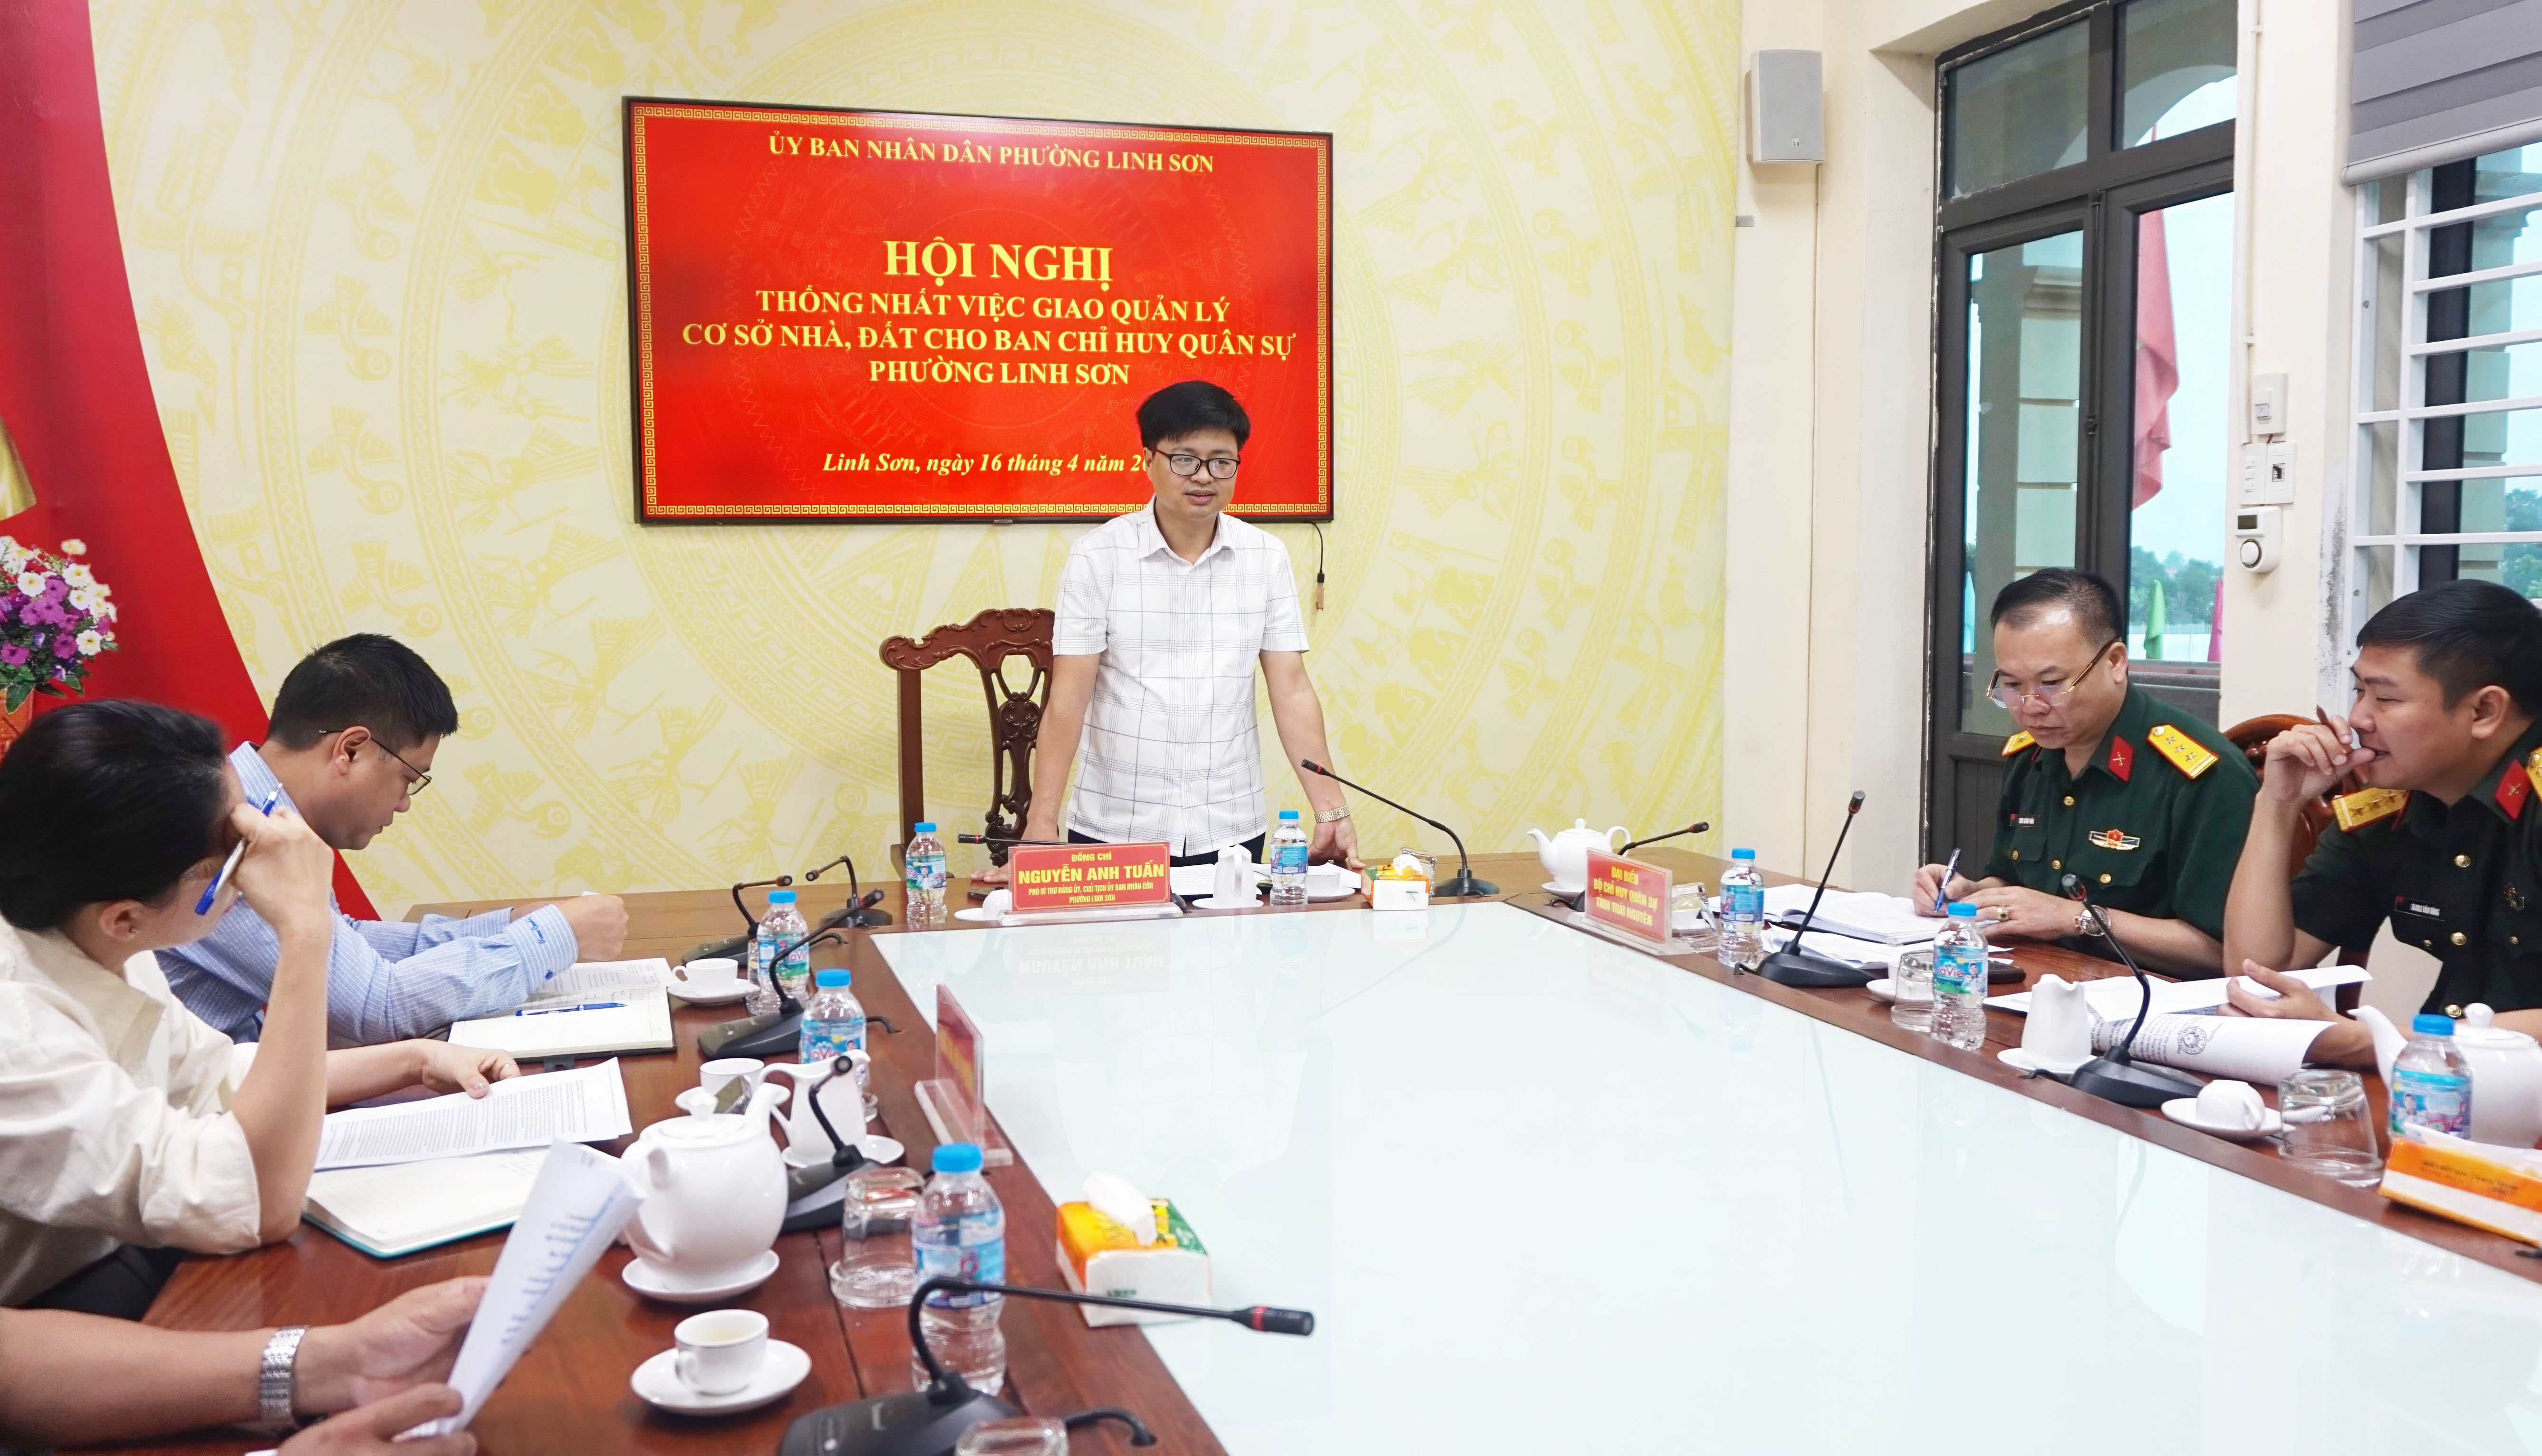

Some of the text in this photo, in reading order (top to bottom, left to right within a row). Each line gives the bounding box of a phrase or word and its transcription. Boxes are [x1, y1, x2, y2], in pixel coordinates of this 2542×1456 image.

[770, 131, 1213, 172] ỦY BAN NHÂN DÂN PHƯỜNG LINH SƠN
[883, 237, 1113, 291] HỘI NGHỊ
[756, 284, 1230, 322] THỐNG NHẤT VIỆC GIAO QUẢN LÝ
[683, 320, 1296, 358] CƠ SỞ NHÀ, ĐẤT CHO BAN CHỈ HUY QUÂN SỰ
[869, 360, 1129, 384] PHƯỜNG LINH SƠN
[823, 453, 1146, 475] Linh Sơn, ngày 16 tháng 4 năm 2
[1019, 860, 1164, 884] NGUYỄN ANH TUẤN
